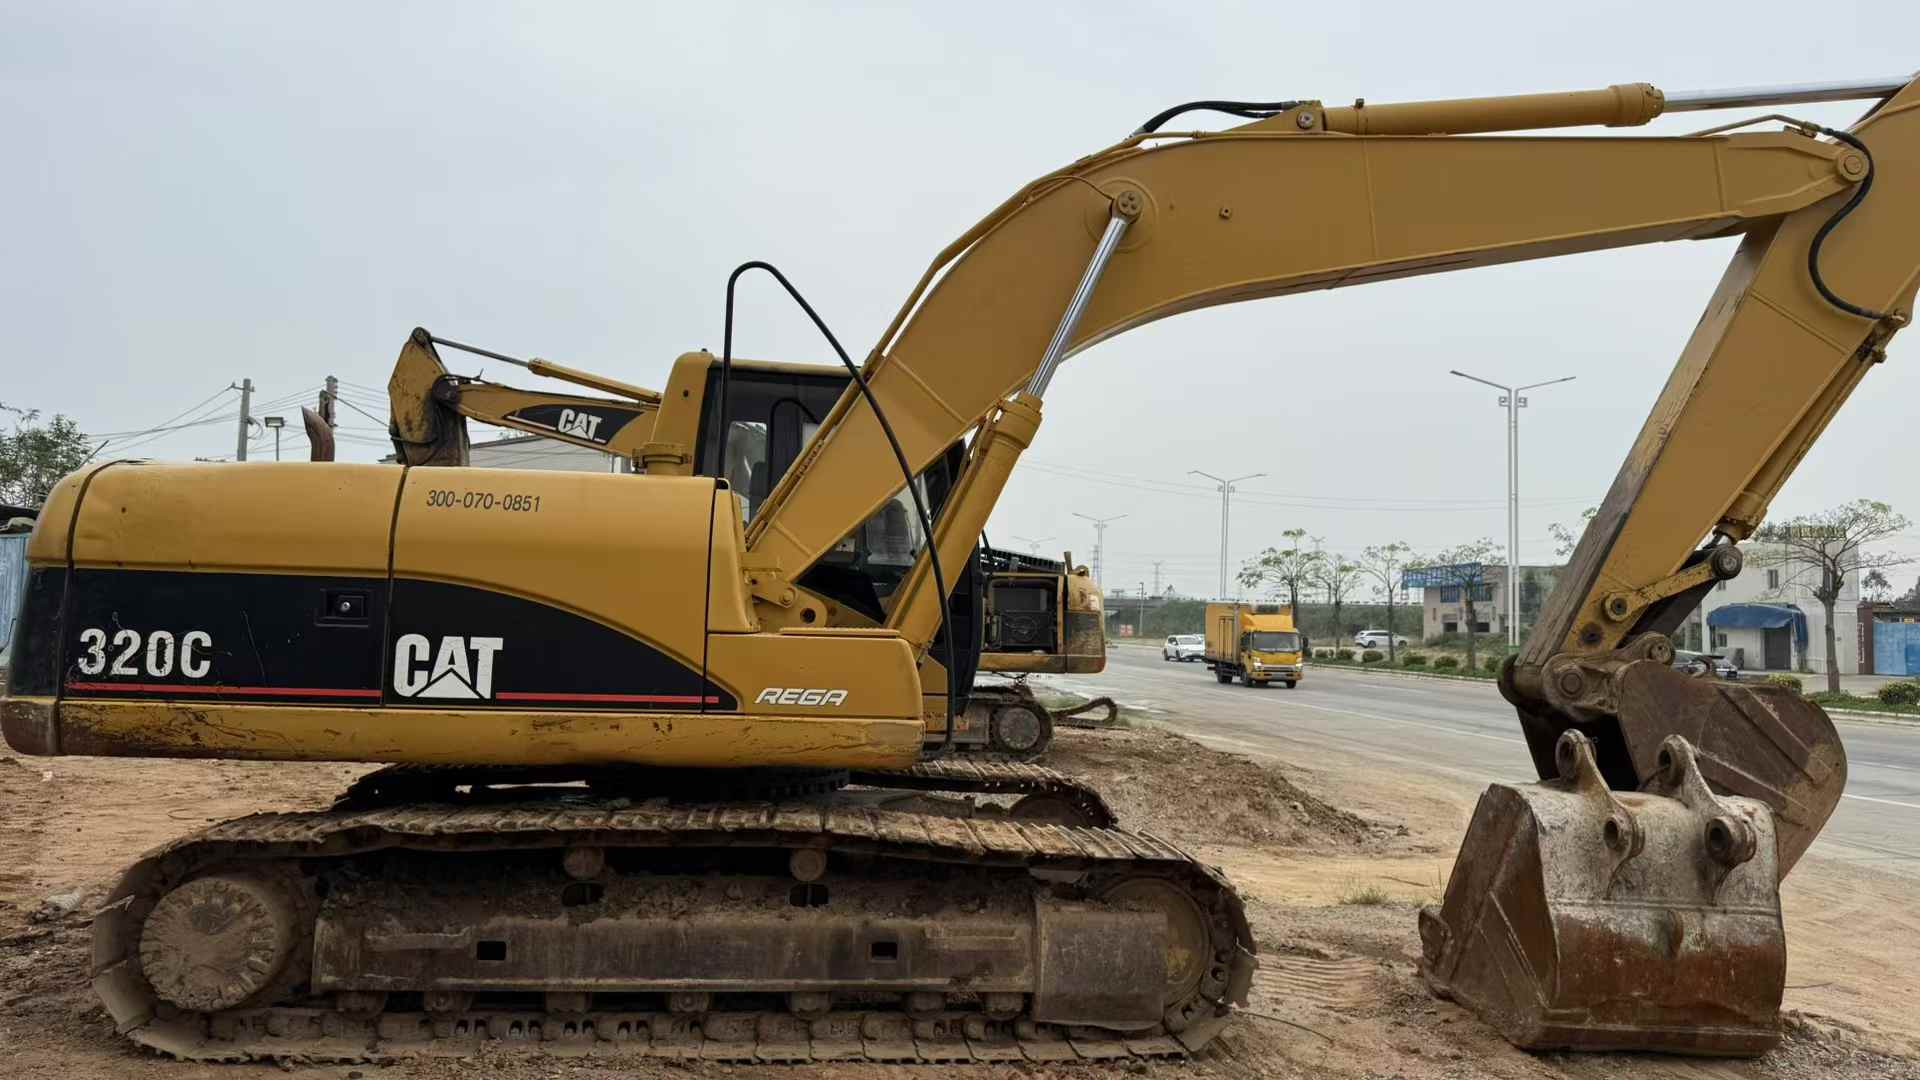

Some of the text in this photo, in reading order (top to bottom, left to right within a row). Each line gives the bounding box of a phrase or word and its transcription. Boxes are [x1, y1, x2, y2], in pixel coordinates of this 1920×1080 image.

[559, 408, 602, 440] CAT
[426, 489, 541, 512] 300-070-0851
[78, 628, 212, 678] 320C
[394, 633, 504, 699] CAT
[754, 687, 849, 706] REGA
